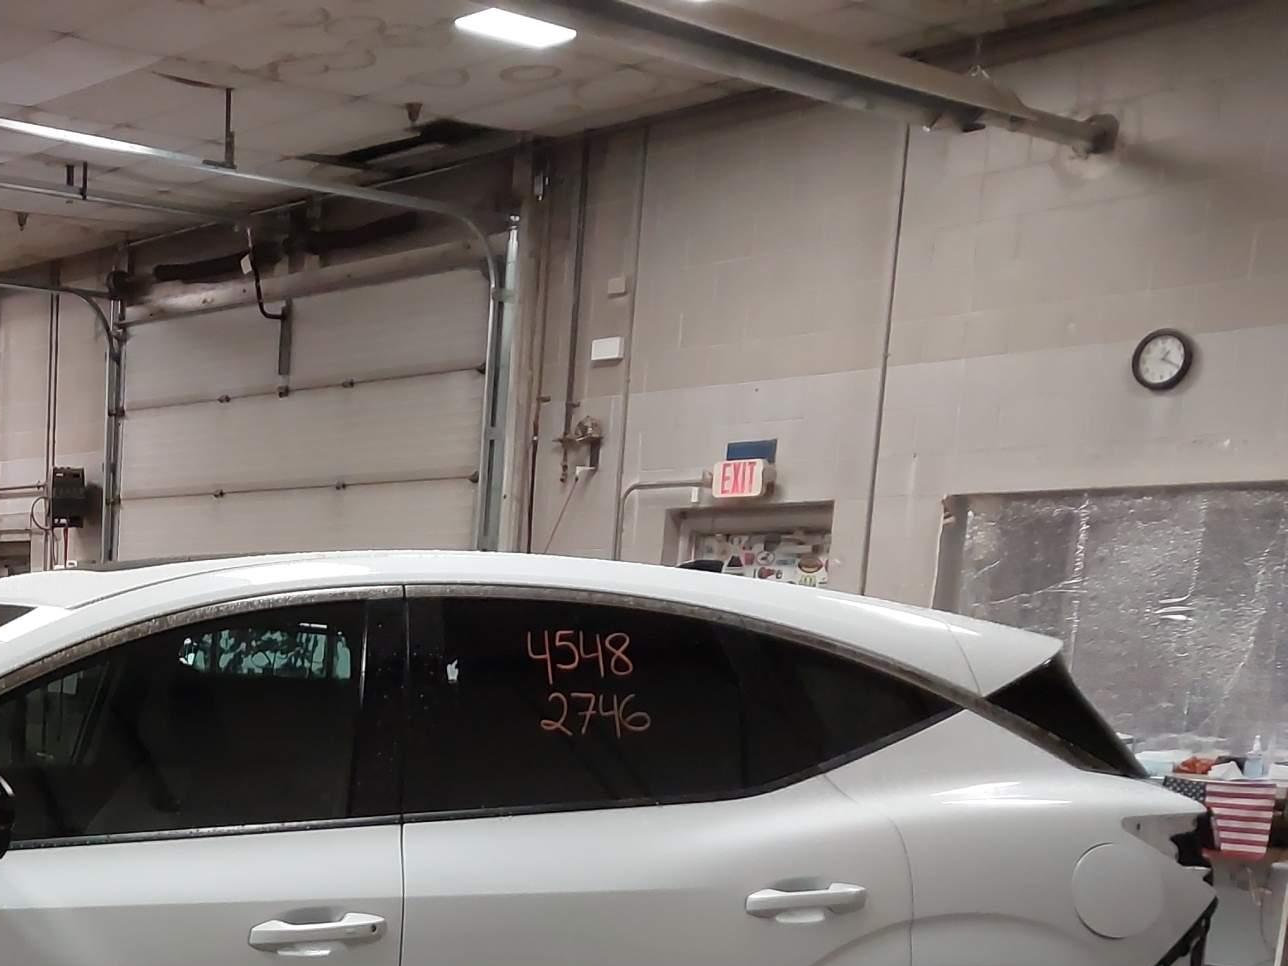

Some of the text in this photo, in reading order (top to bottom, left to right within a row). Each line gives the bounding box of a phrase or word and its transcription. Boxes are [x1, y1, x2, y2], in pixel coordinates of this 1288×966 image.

[721, 461, 757, 494] EXIT
[527, 630, 634, 685] 4548
[540, 692, 651, 738] 2746
